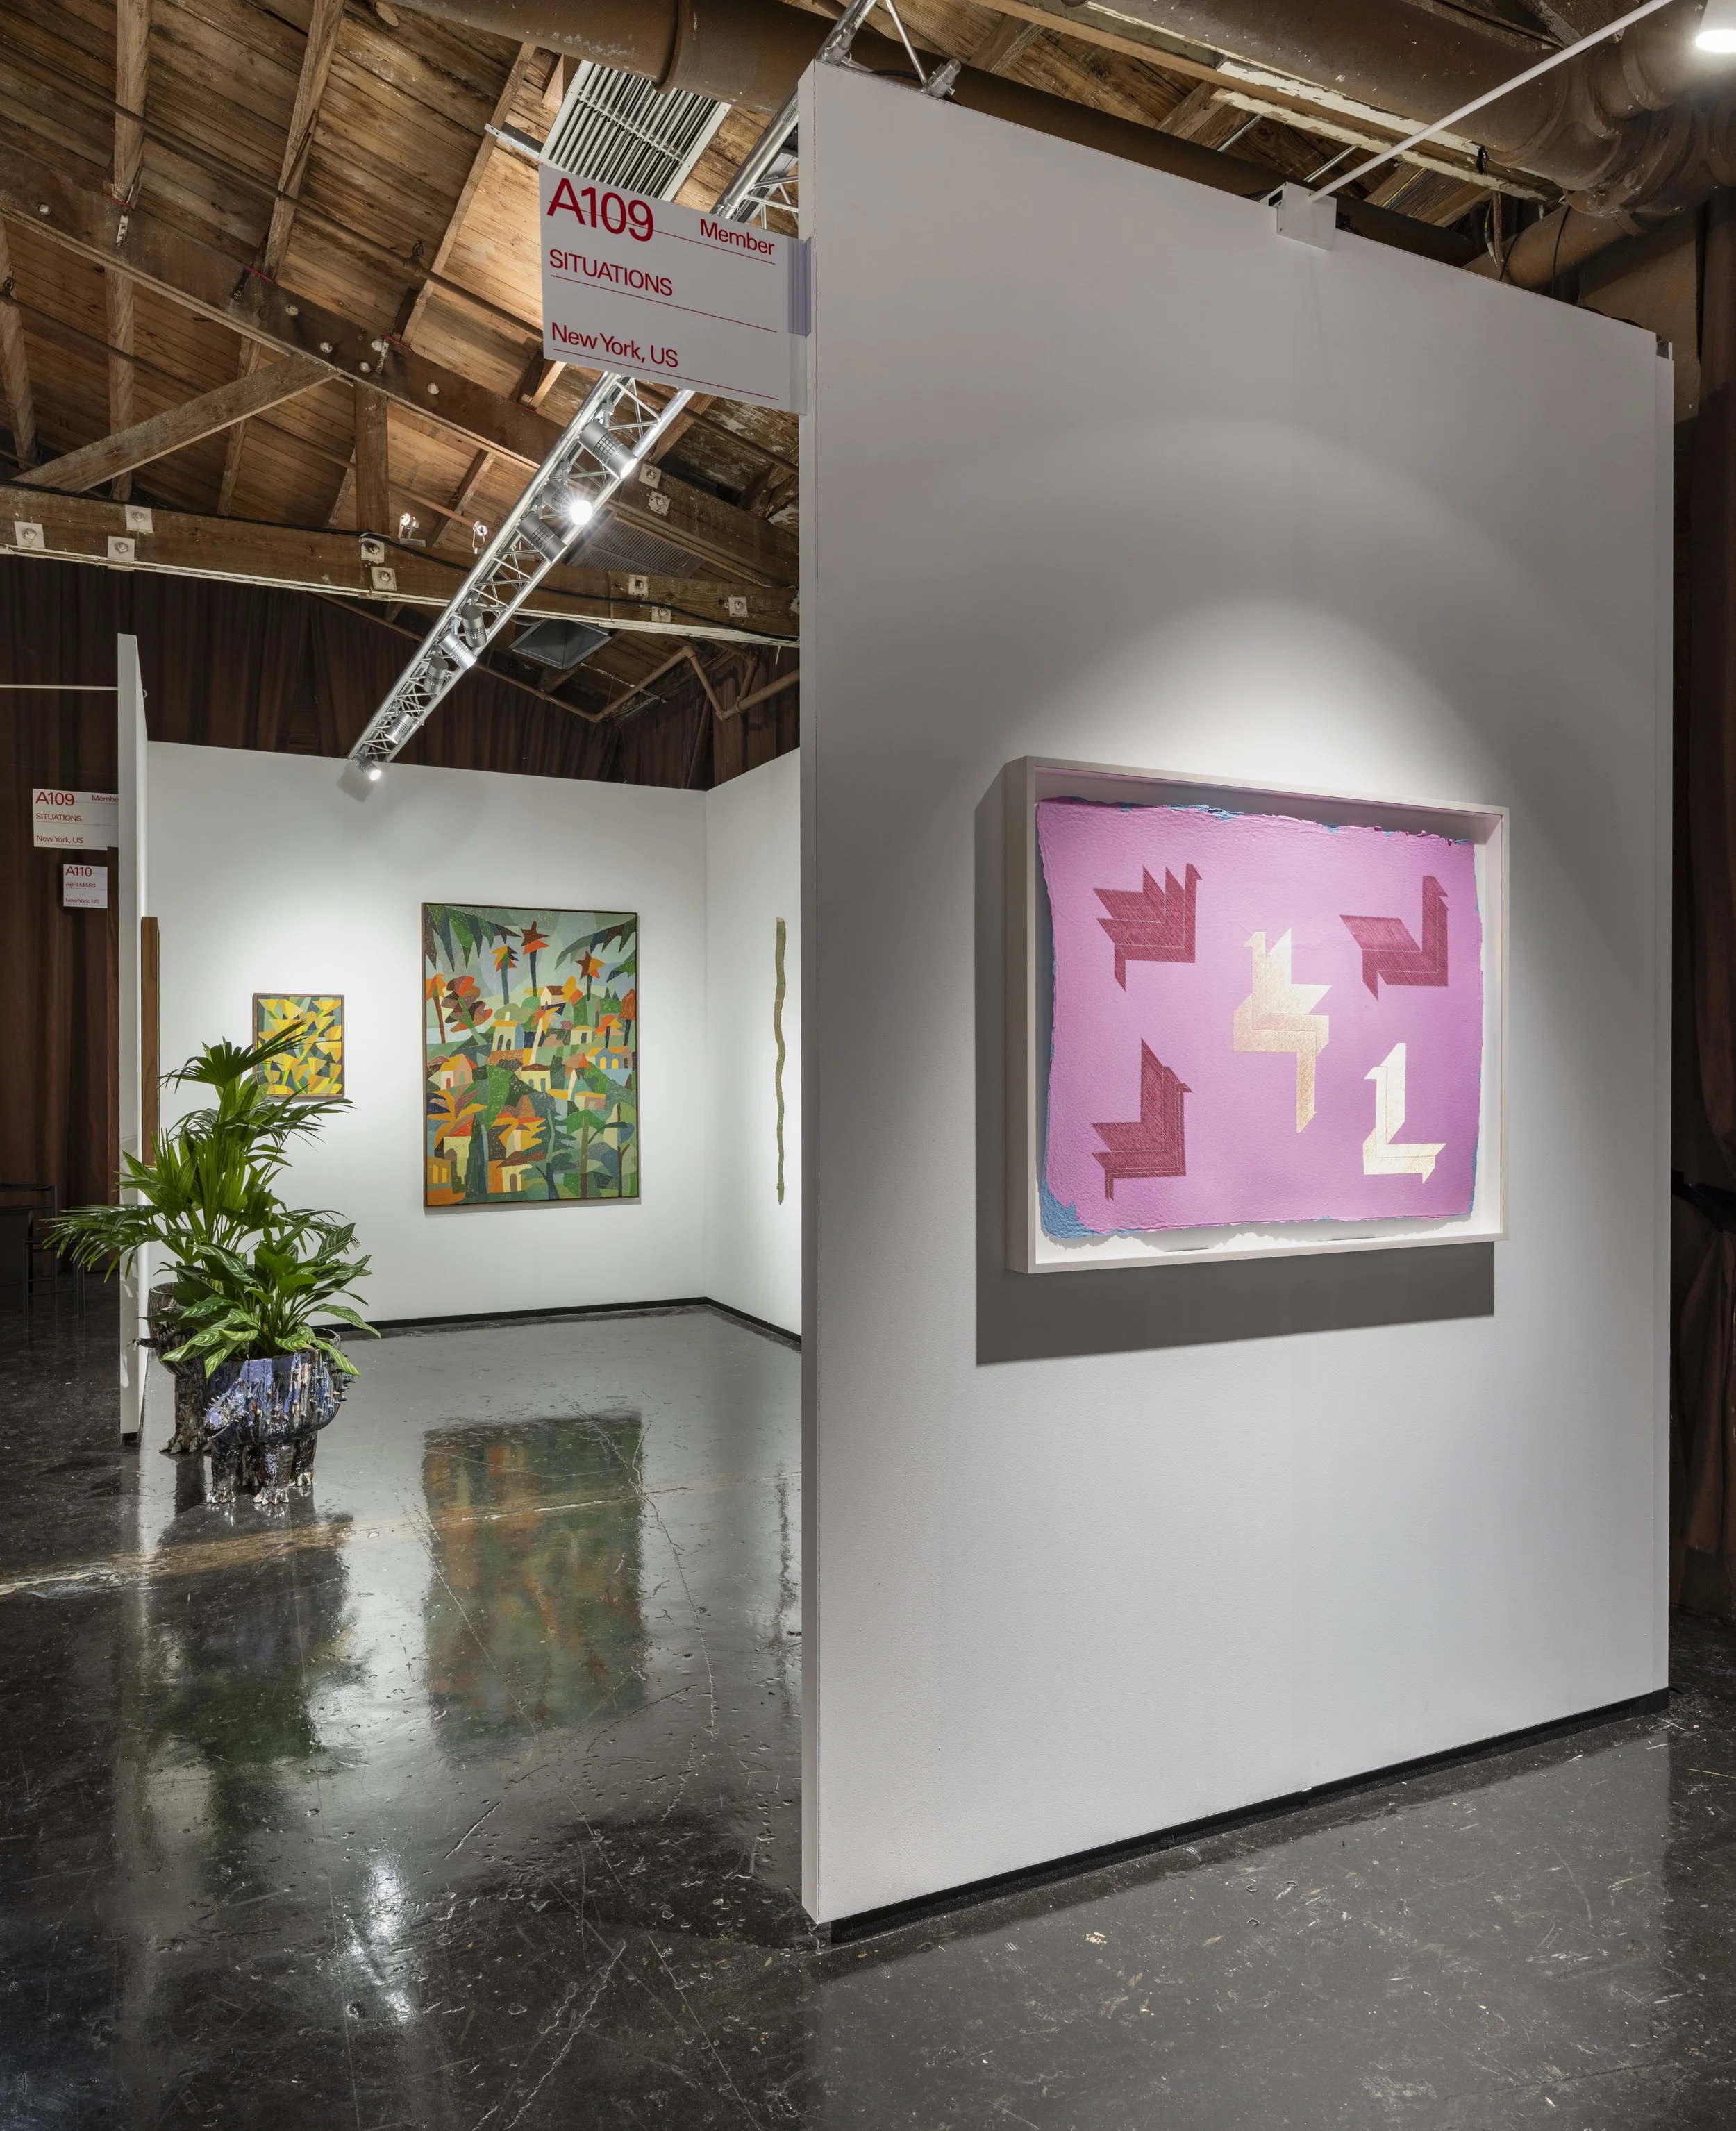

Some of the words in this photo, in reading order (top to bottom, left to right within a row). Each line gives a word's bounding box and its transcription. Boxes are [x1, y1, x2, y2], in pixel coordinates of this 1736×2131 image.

[546, 177, 654, 242] A109
[700, 219, 775, 256] Member
[549, 249, 673, 296] SITUATIONS
[551, 321, 598, 349] New
[599, 333, 645, 364] York,
[650, 345, 679, 368] US
[35, 791, 75, 806] A109
[92, 794, 119, 803] Membe
[35, 812, 82, 822] SITUATIONS
[65, 866, 92, 877] A110
